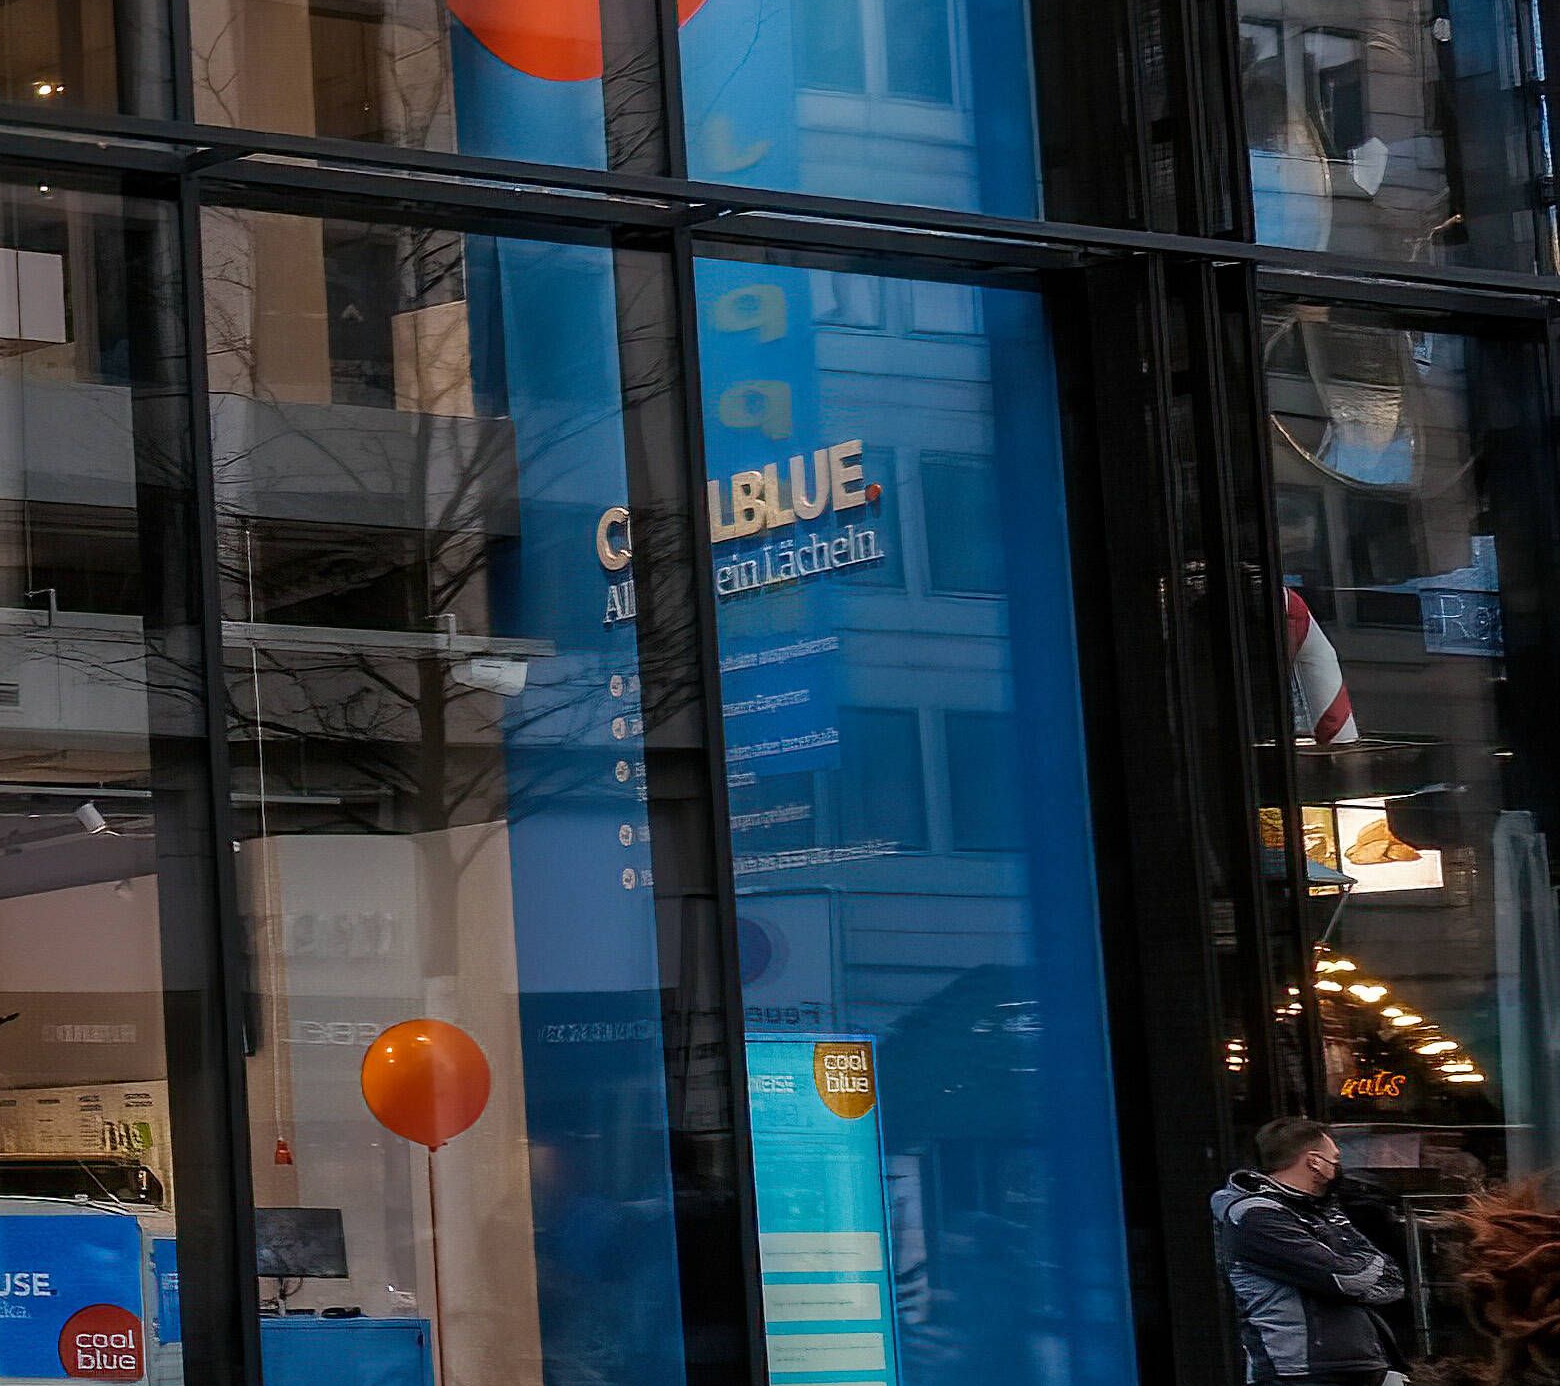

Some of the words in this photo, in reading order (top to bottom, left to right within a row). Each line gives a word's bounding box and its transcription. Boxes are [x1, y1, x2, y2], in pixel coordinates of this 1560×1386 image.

[823, 1050, 868, 1072] cool
[826, 1072, 870, 1095] blue
[75, 1329, 136, 1349] cool
[77, 1349, 137, 1370] blue
